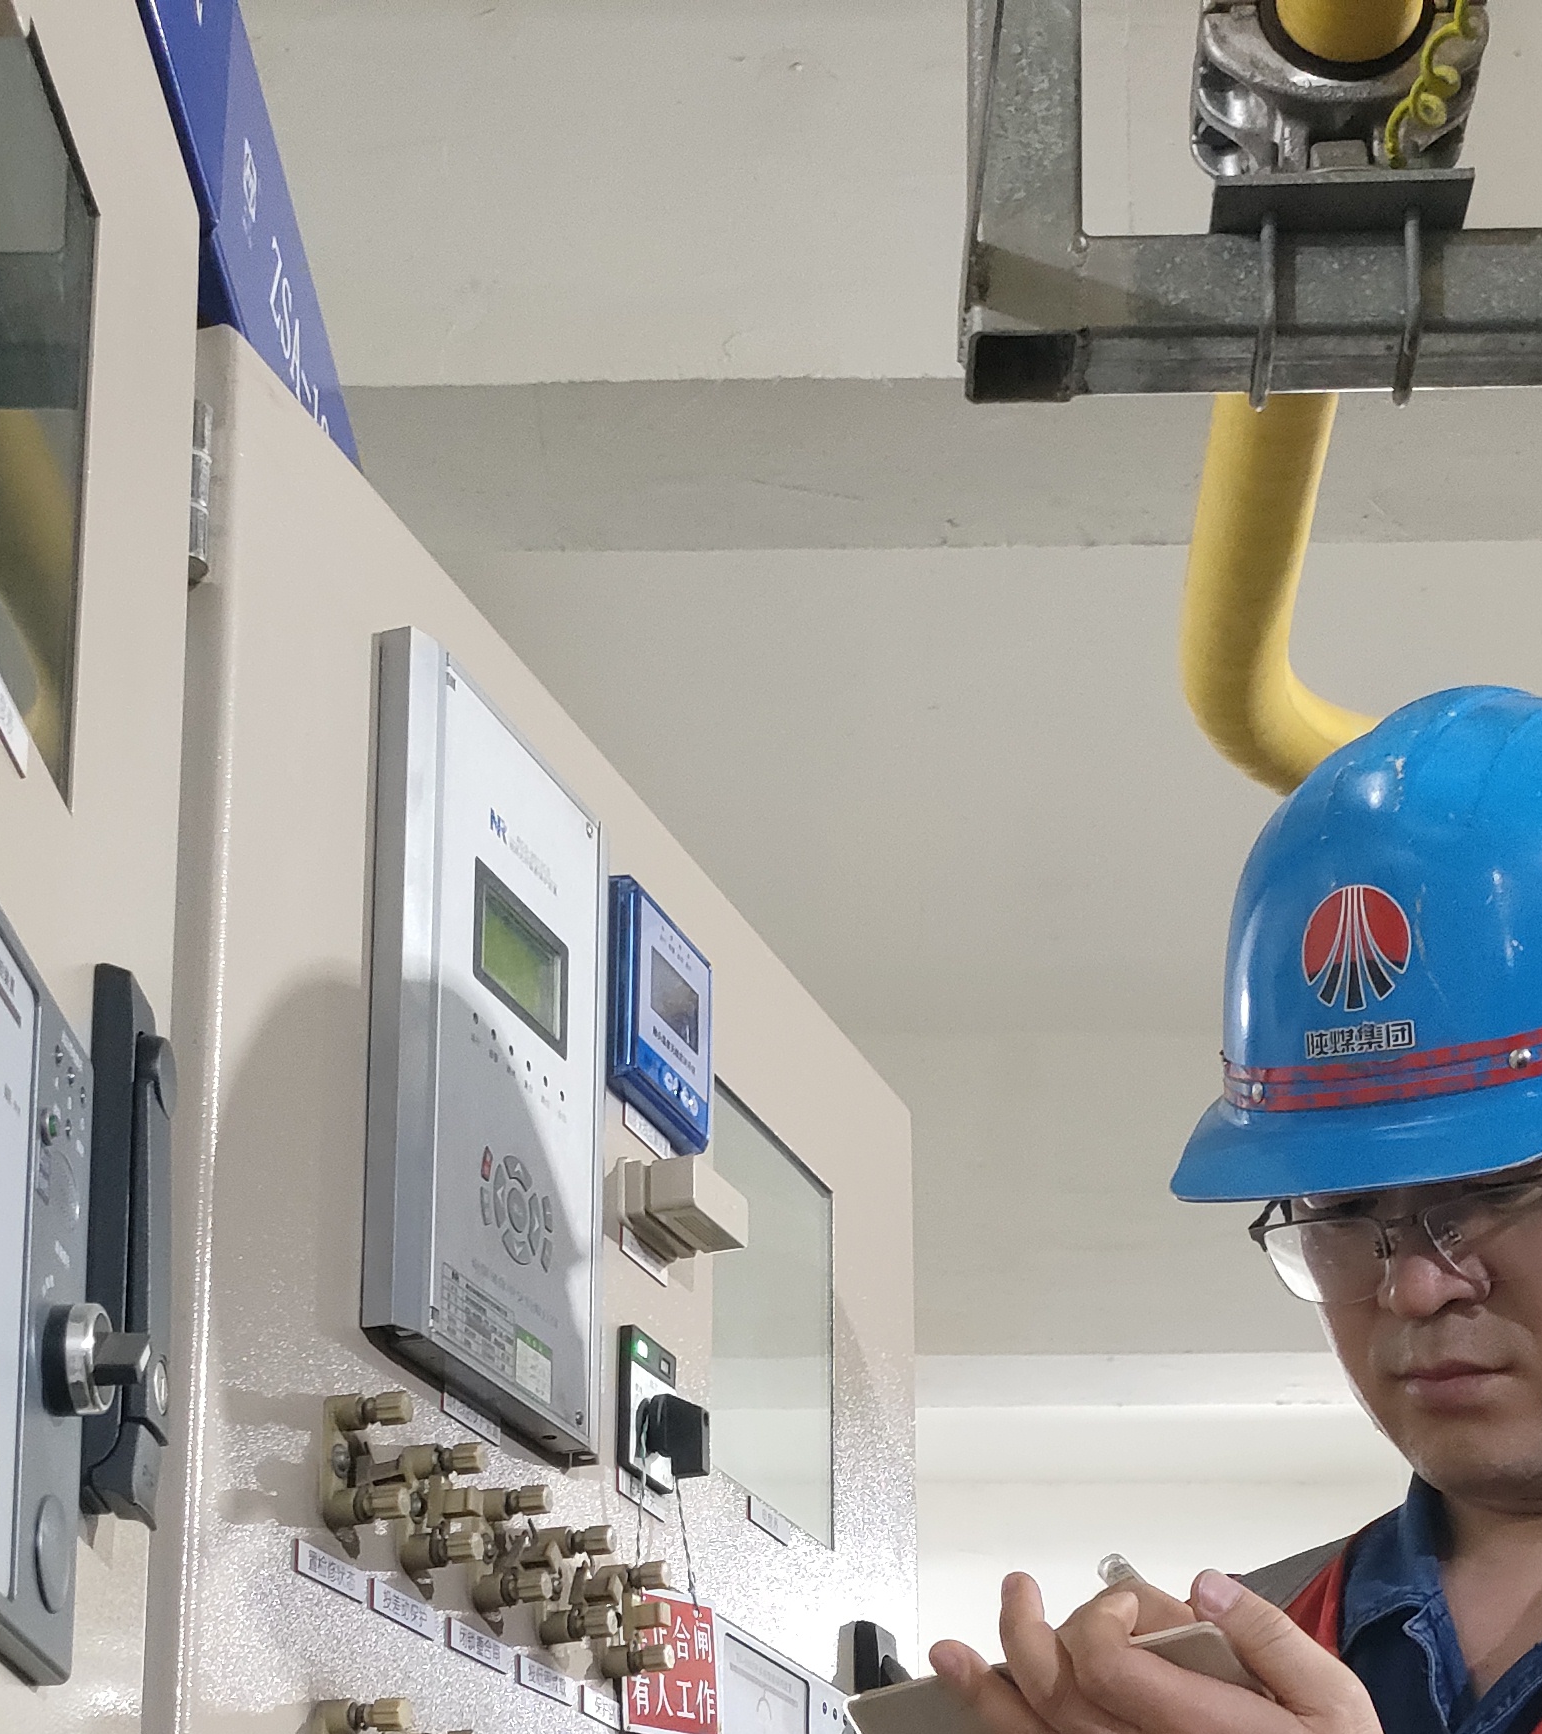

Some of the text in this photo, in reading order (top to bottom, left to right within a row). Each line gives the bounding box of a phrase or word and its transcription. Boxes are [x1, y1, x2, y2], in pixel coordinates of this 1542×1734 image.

[1305, 1019, 1415, 1059] 陕煤集团
[631, 1672, 716, 1724] 有人工作
